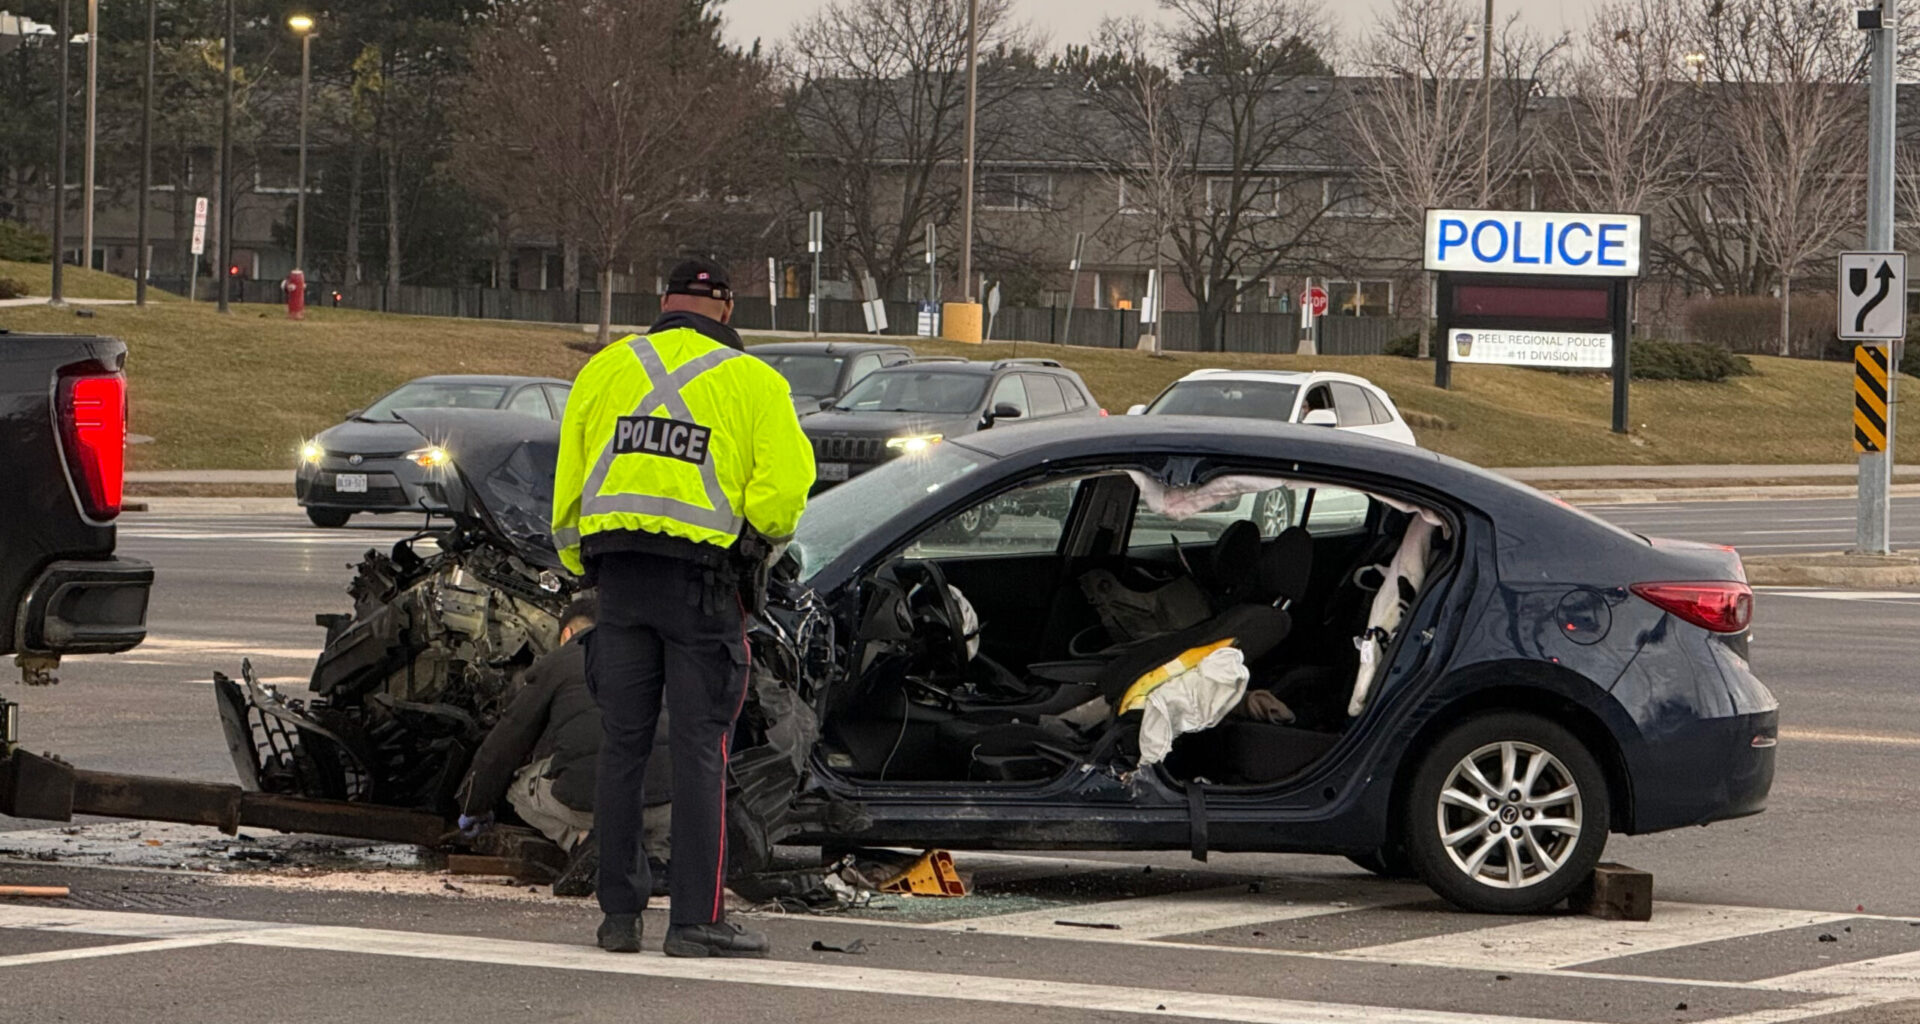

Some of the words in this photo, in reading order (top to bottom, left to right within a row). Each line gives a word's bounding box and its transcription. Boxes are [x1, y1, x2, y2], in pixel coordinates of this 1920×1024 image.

[1438, 219, 1627, 266] POLICE
[1478, 333, 1505, 344] PEEL
[1508, 335, 1563, 346] REGIONAL
[1567, 337, 1605, 347] POLICE
[1530, 351, 1578, 362] DIVISION
[617, 420, 706, 460] POLICE
